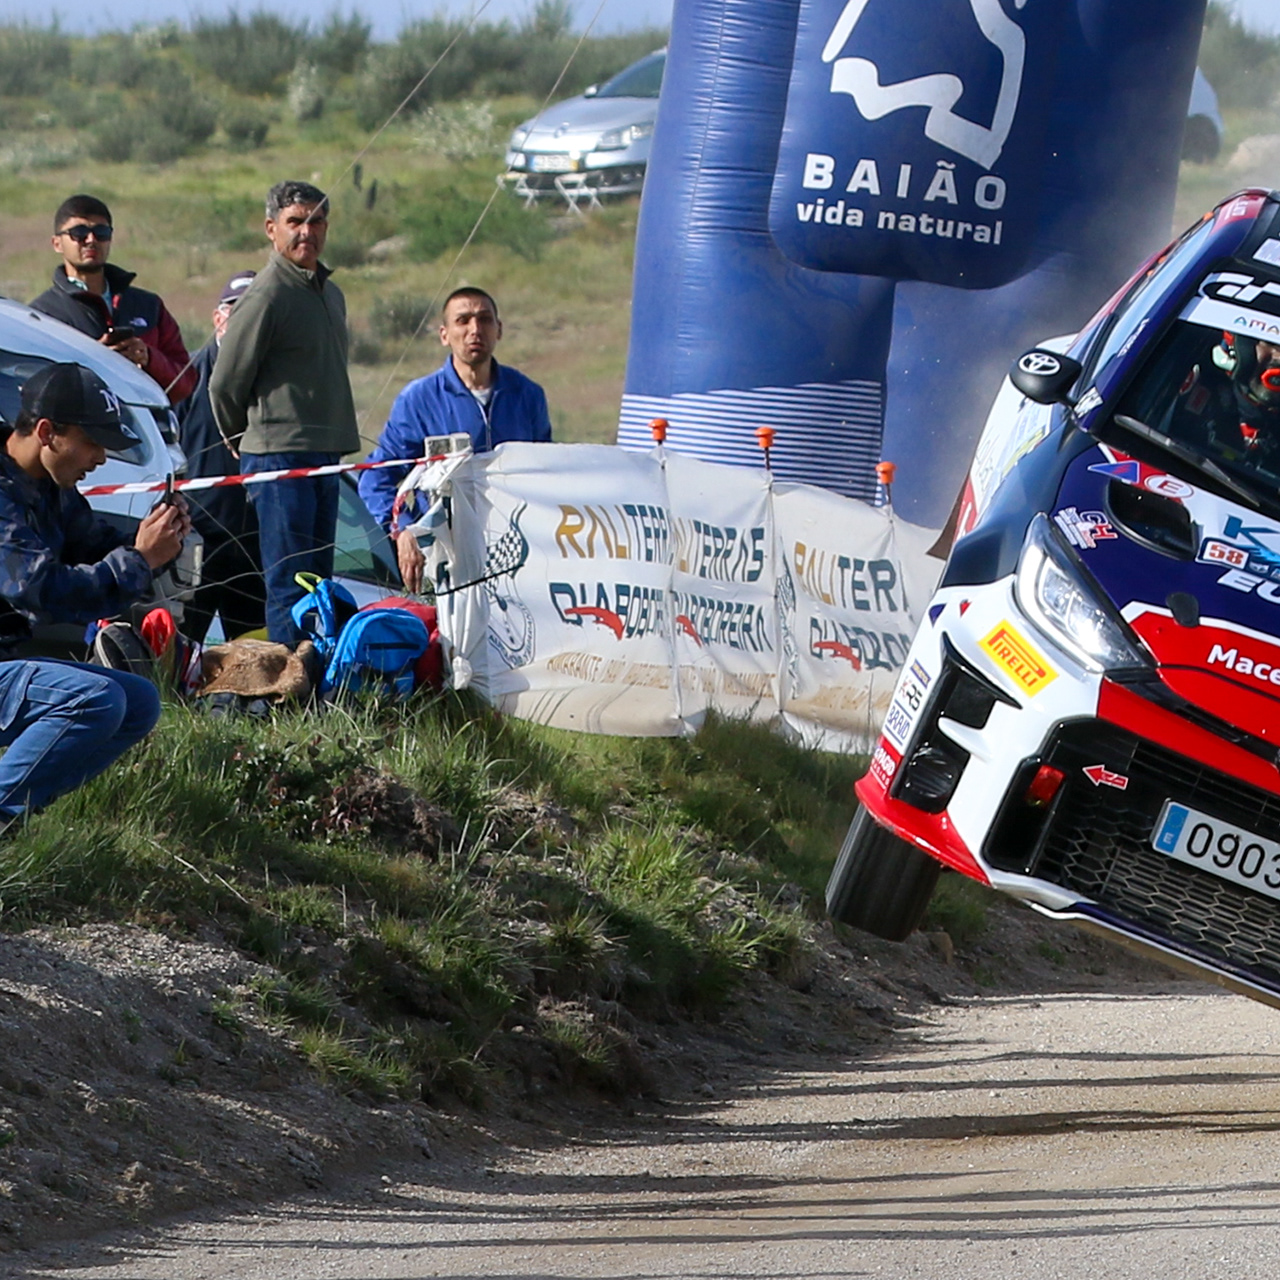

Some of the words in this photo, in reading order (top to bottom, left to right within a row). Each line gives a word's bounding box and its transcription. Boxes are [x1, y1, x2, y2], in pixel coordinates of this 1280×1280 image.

[803, 153, 1006, 210] BAIÃO
[797, 199, 864, 227] vida
[877, 210, 1003, 245] natural
[1208, 543, 1244, 567] 58
[987, 628, 1047, 688] PIRELLI
[887, 705, 911, 741] BRAID
[1163, 832, 1174, 845] E
